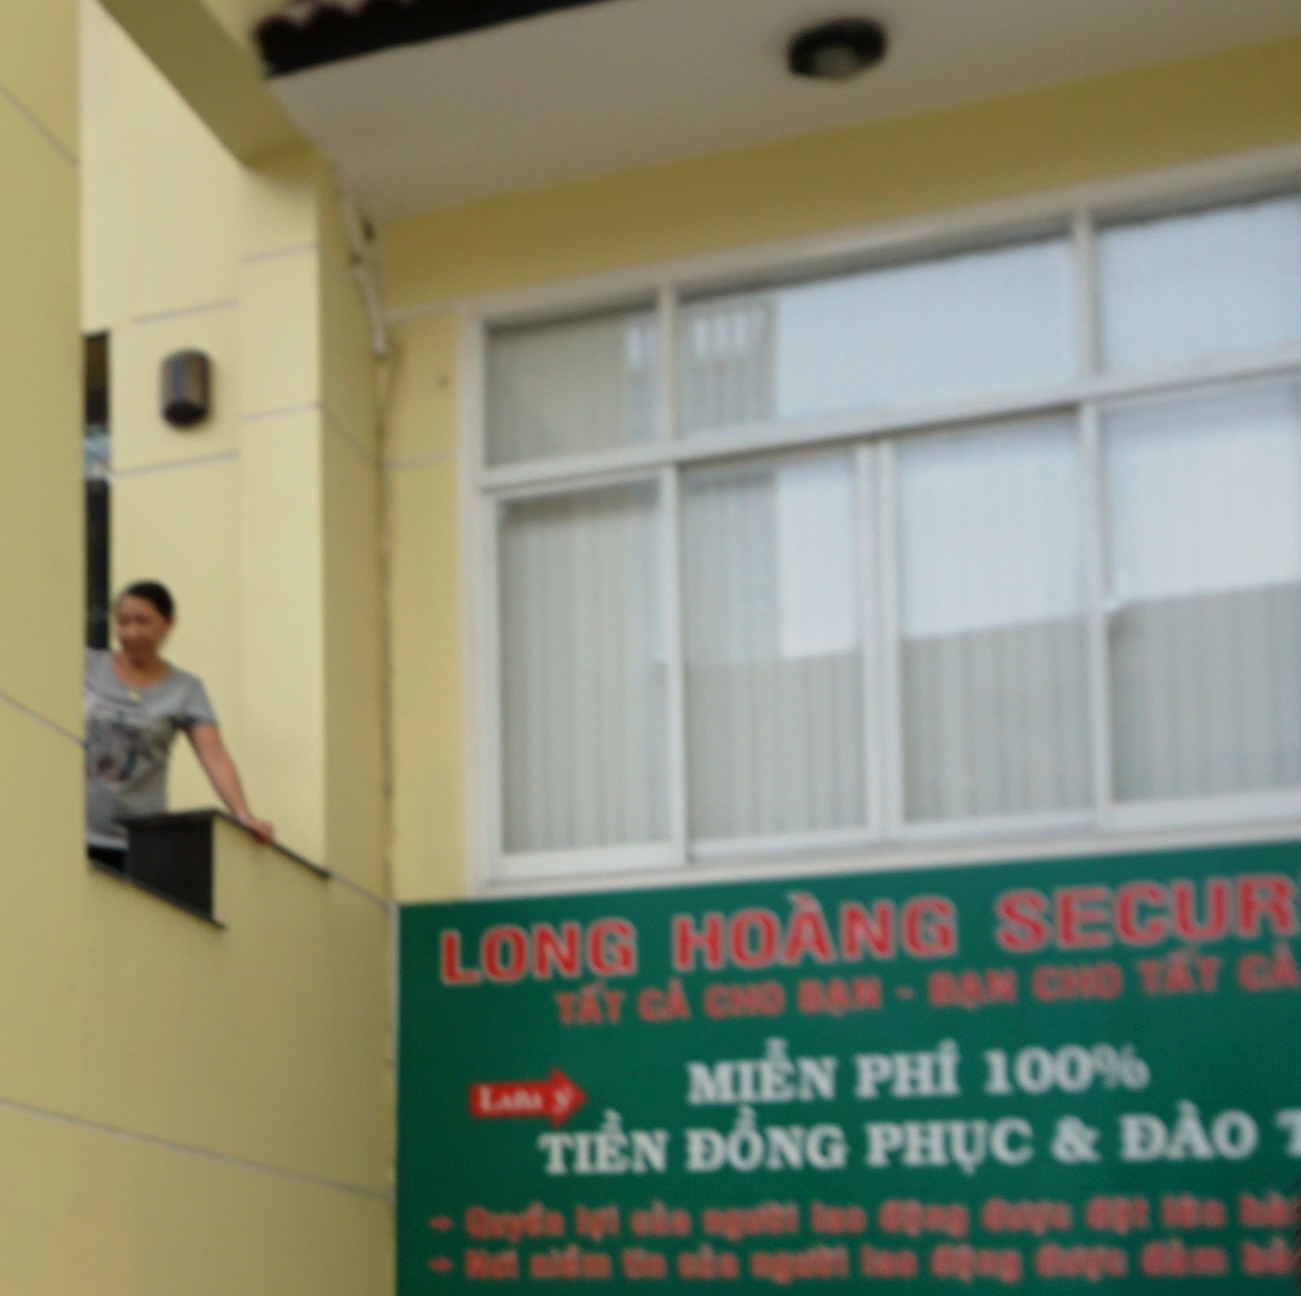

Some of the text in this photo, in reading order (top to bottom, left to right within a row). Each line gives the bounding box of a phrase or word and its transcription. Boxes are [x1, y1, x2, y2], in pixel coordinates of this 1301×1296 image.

[439, 917, 638, 985] LONG
[671, 893, 958, 972] HOÀNG
[703, 981, 785, 1018] CHO
[1031, 962, 1124, 1002] CHO
[685, 1037, 1151, 1105] MIỄN PHÍ 100%
[537, 1108, 669, 1176] TIỀN
[685, 1104, 848, 1172] ĐỒNG
[864, 1116, 1035, 1176] PHỤC
[1051, 1114, 1101, 1164] &
[1119, 1100, 1259, 1162] ĐÀO
